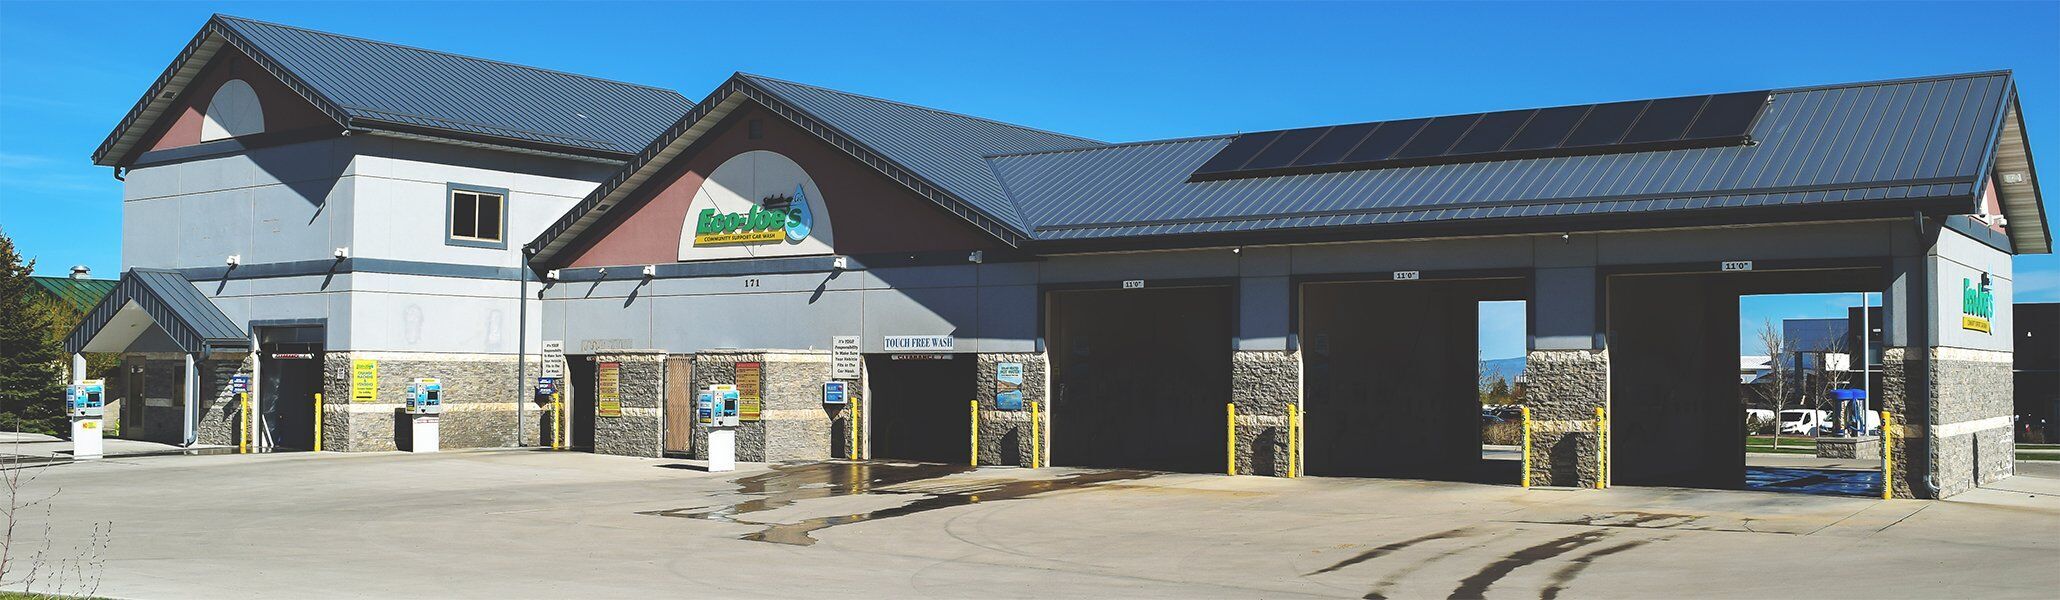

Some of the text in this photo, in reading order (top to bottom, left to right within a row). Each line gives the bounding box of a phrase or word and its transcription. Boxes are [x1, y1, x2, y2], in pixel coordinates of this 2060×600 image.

[745, 279, 759, 287] 171
[885, 337, 953, 348] TOUCH FREE WASH
